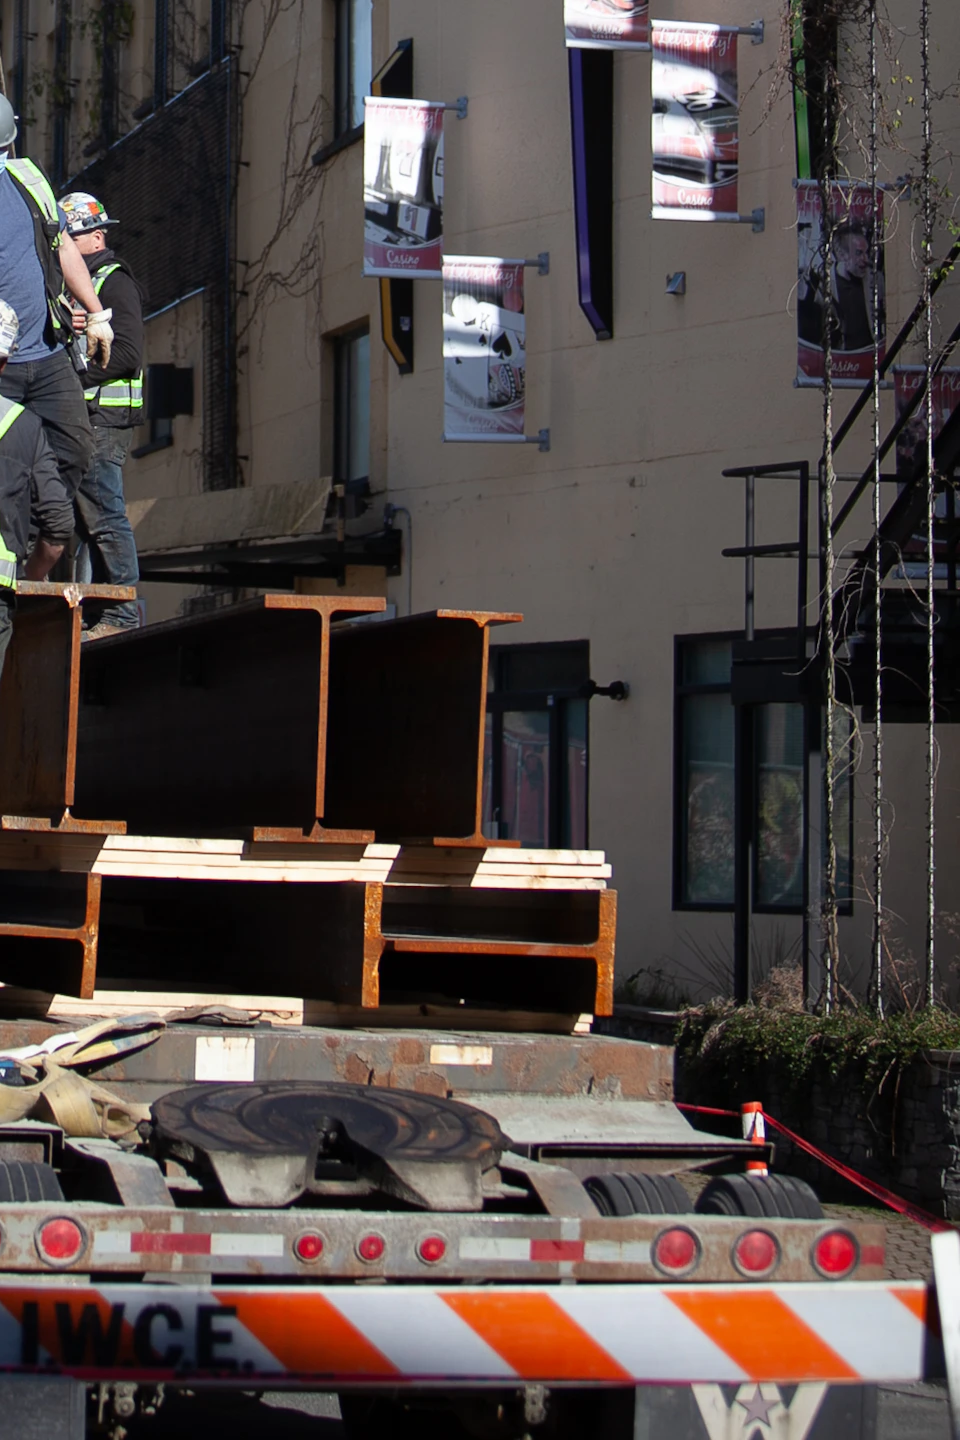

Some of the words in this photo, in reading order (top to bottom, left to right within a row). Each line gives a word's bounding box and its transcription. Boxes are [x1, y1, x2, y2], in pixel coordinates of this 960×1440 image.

[658, 28, 693, 47] Let's
[695, 29, 733, 57] Play!
[677, 187, 713, 206] Casino
[386, 249, 420, 266] Casino
[830, 360, 860, 373] asino
